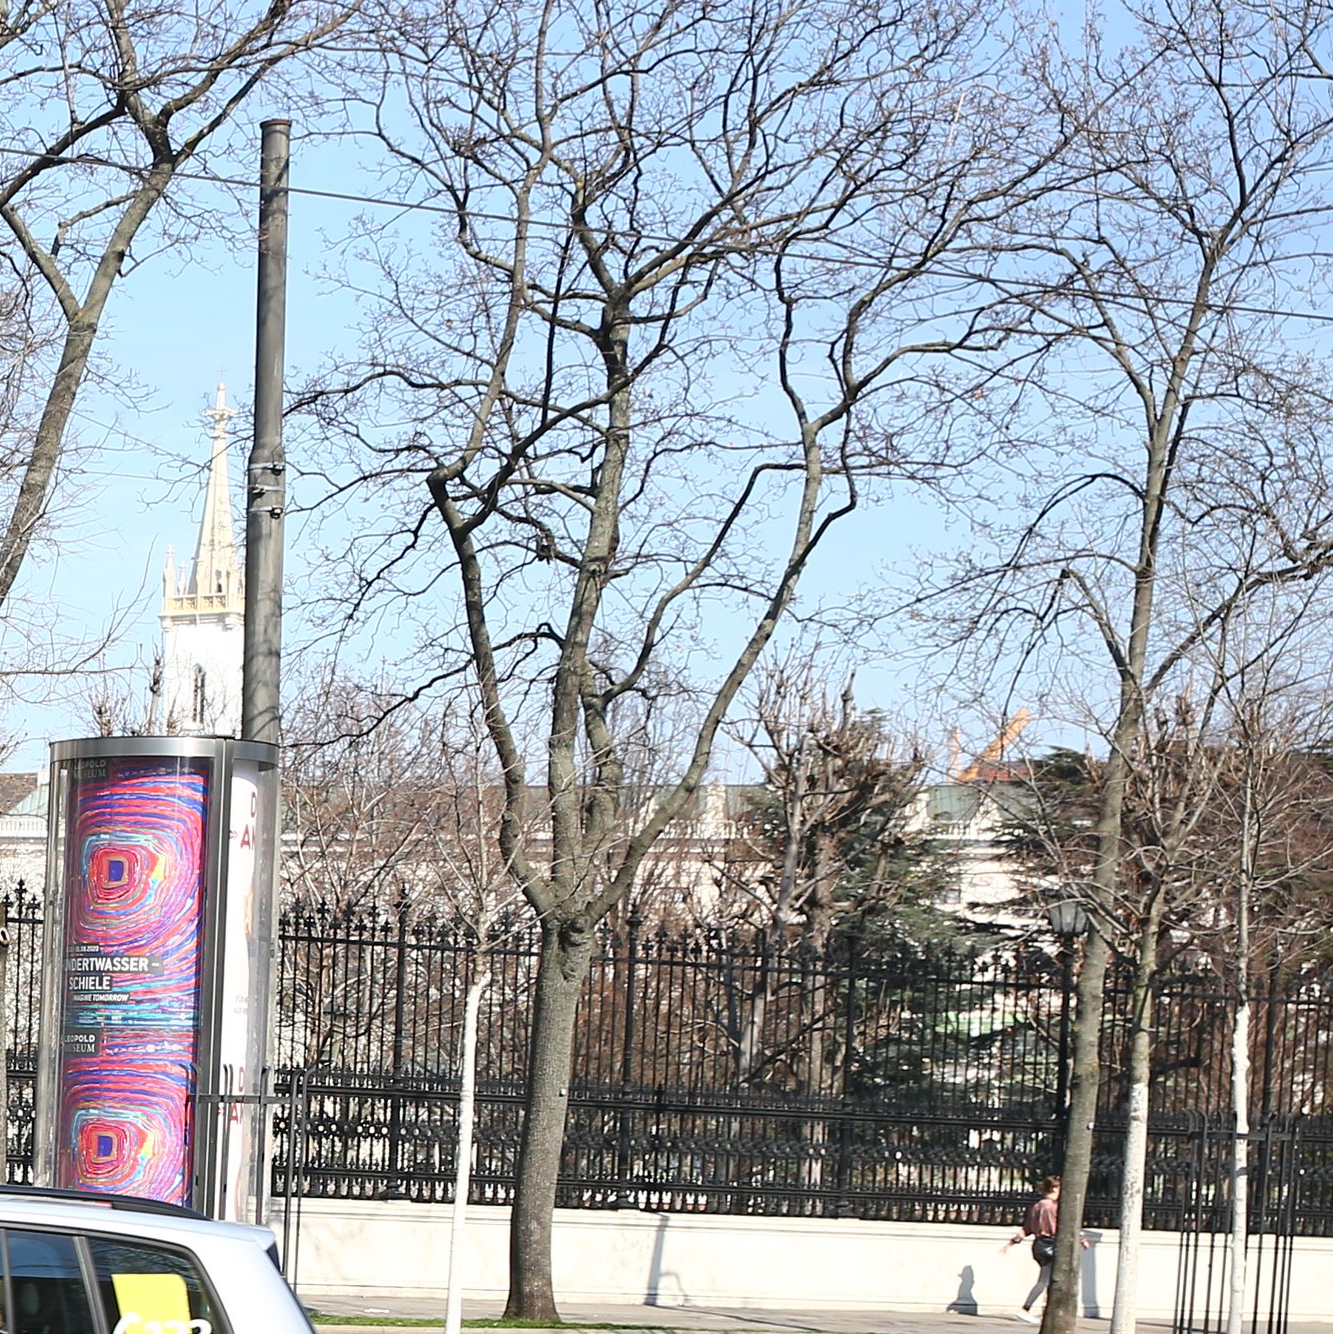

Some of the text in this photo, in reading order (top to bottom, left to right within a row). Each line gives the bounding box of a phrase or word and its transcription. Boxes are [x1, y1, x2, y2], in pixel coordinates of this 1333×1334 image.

[69, 976, 111, 990] SCHIELE
[92, 993, 129, 1002] TOMORROW
[65, 1043, 95, 1053] SEUM
